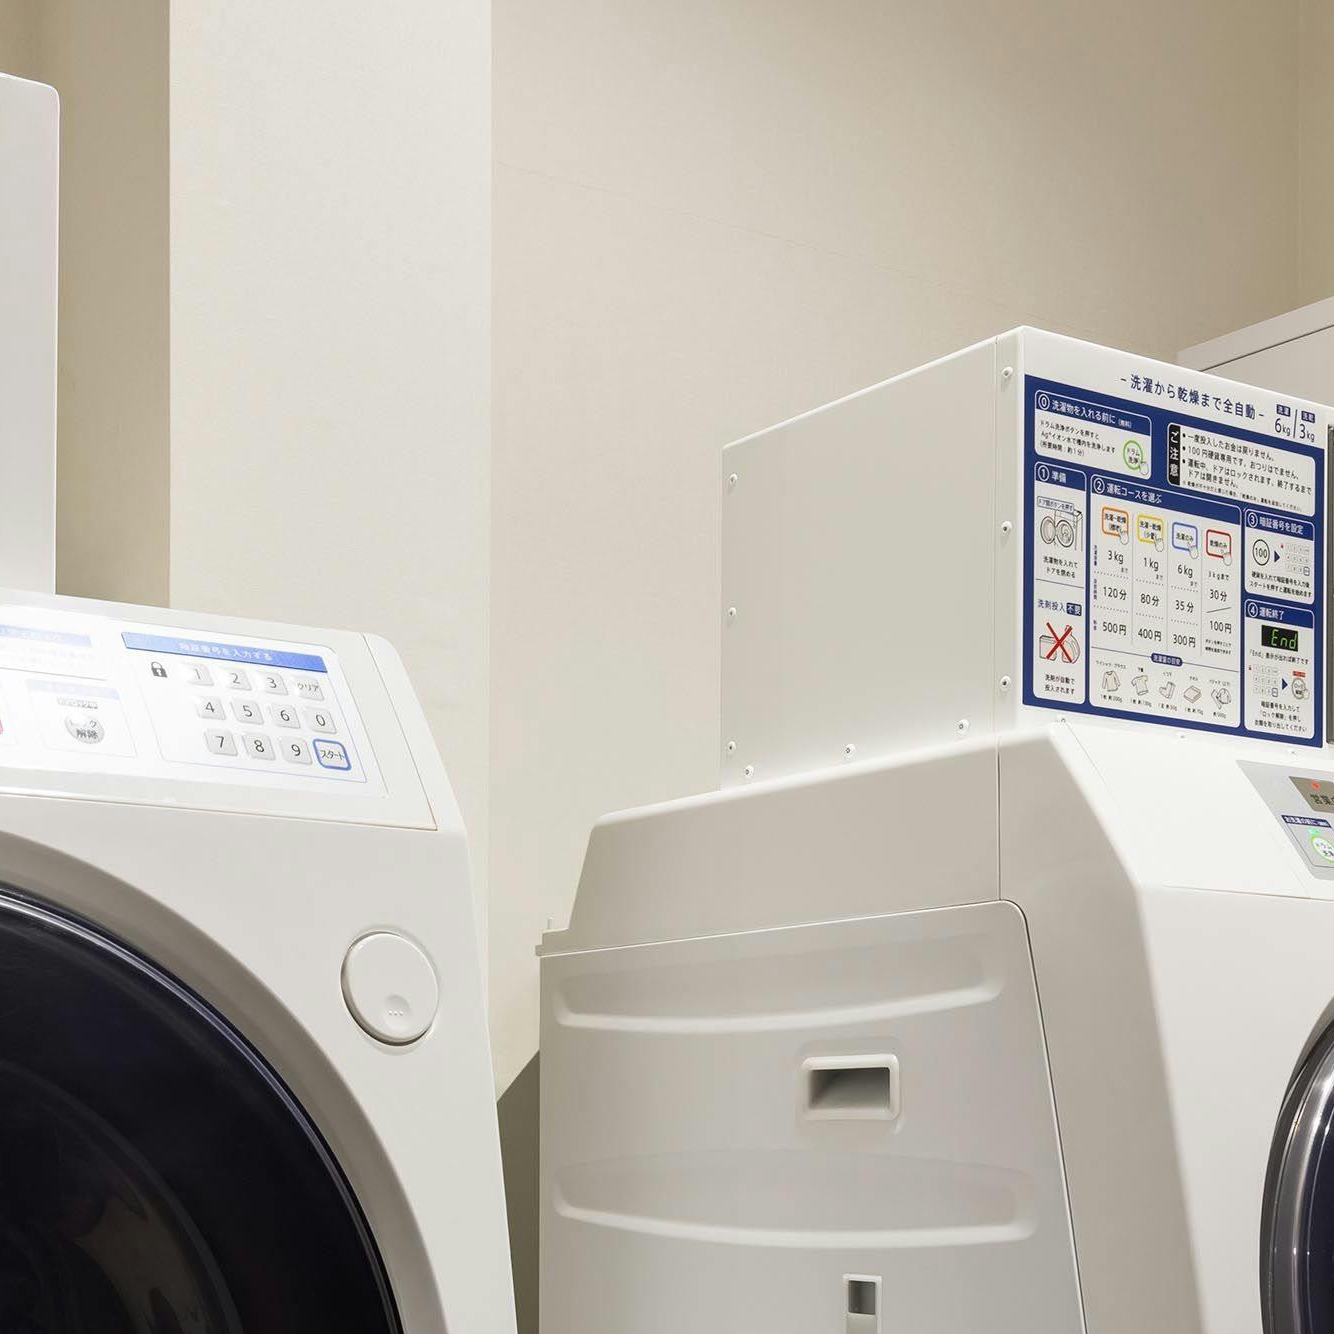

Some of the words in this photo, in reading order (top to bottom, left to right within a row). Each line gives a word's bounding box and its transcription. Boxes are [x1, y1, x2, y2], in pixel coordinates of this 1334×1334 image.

[1270, 628, 1297, 650] End
[231, 673, 241, 684] 2
[267, 678, 277, 689] 3
[205, 701, 215, 714] 4
[243, 705, 253, 717] 5
[280, 709, 290, 722] 6
[316, 714, 326, 727] 0
[215, 736, 225, 748] 7
[254, 740, 265, 753] 8
[291, 744, 301, 757] 9
